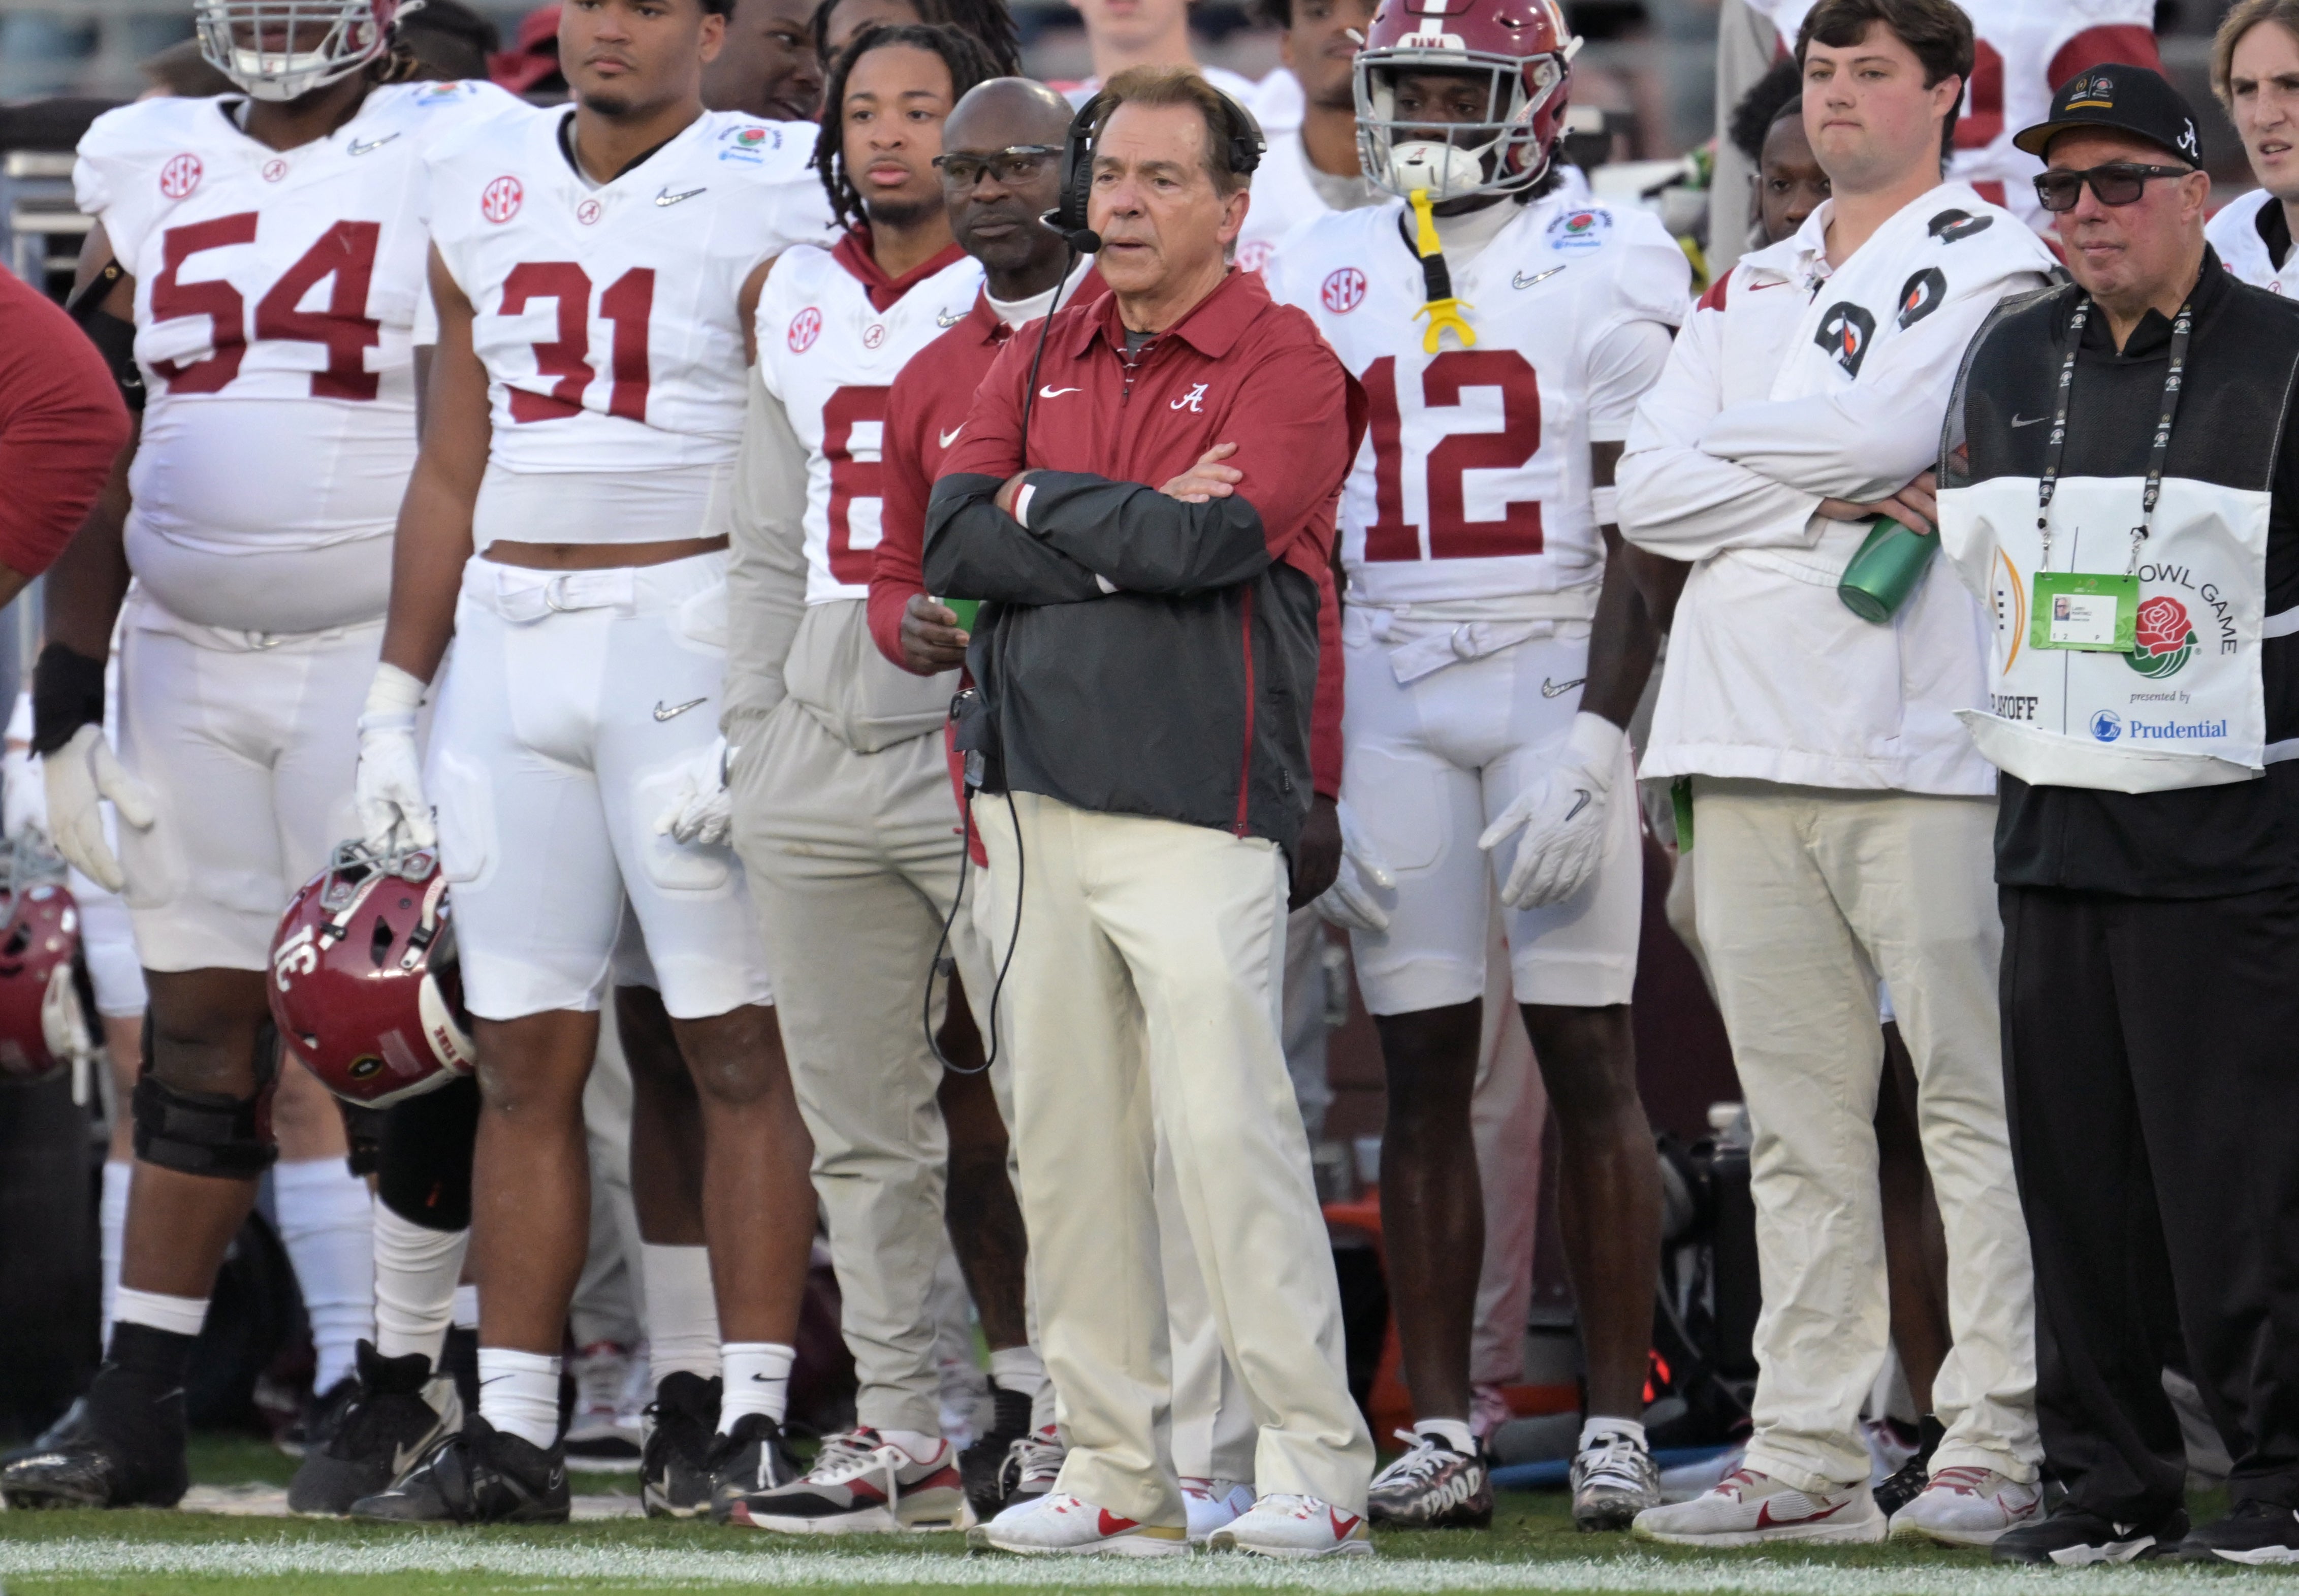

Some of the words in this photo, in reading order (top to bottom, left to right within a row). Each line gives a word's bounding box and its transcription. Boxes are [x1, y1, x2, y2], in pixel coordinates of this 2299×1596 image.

[161, 153, 203, 199] SEC
[482, 176, 523, 224] SEC
[150, 211, 380, 400] 54
[1321, 268, 1366, 314] SEC
[498, 262, 655, 424] 31
[788, 307, 822, 353] SEC
[1170, 382, 1209, 412] A
[1361, 349, 1544, 562] 12
[2138, 563, 2195, 590] OWL
[2201, 584, 2237, 655] GAME
[2130, 691, 2176, 704] presented
[2179, 691, 2191, 704] by
[2130, 719, 2228, 739] Prudential
